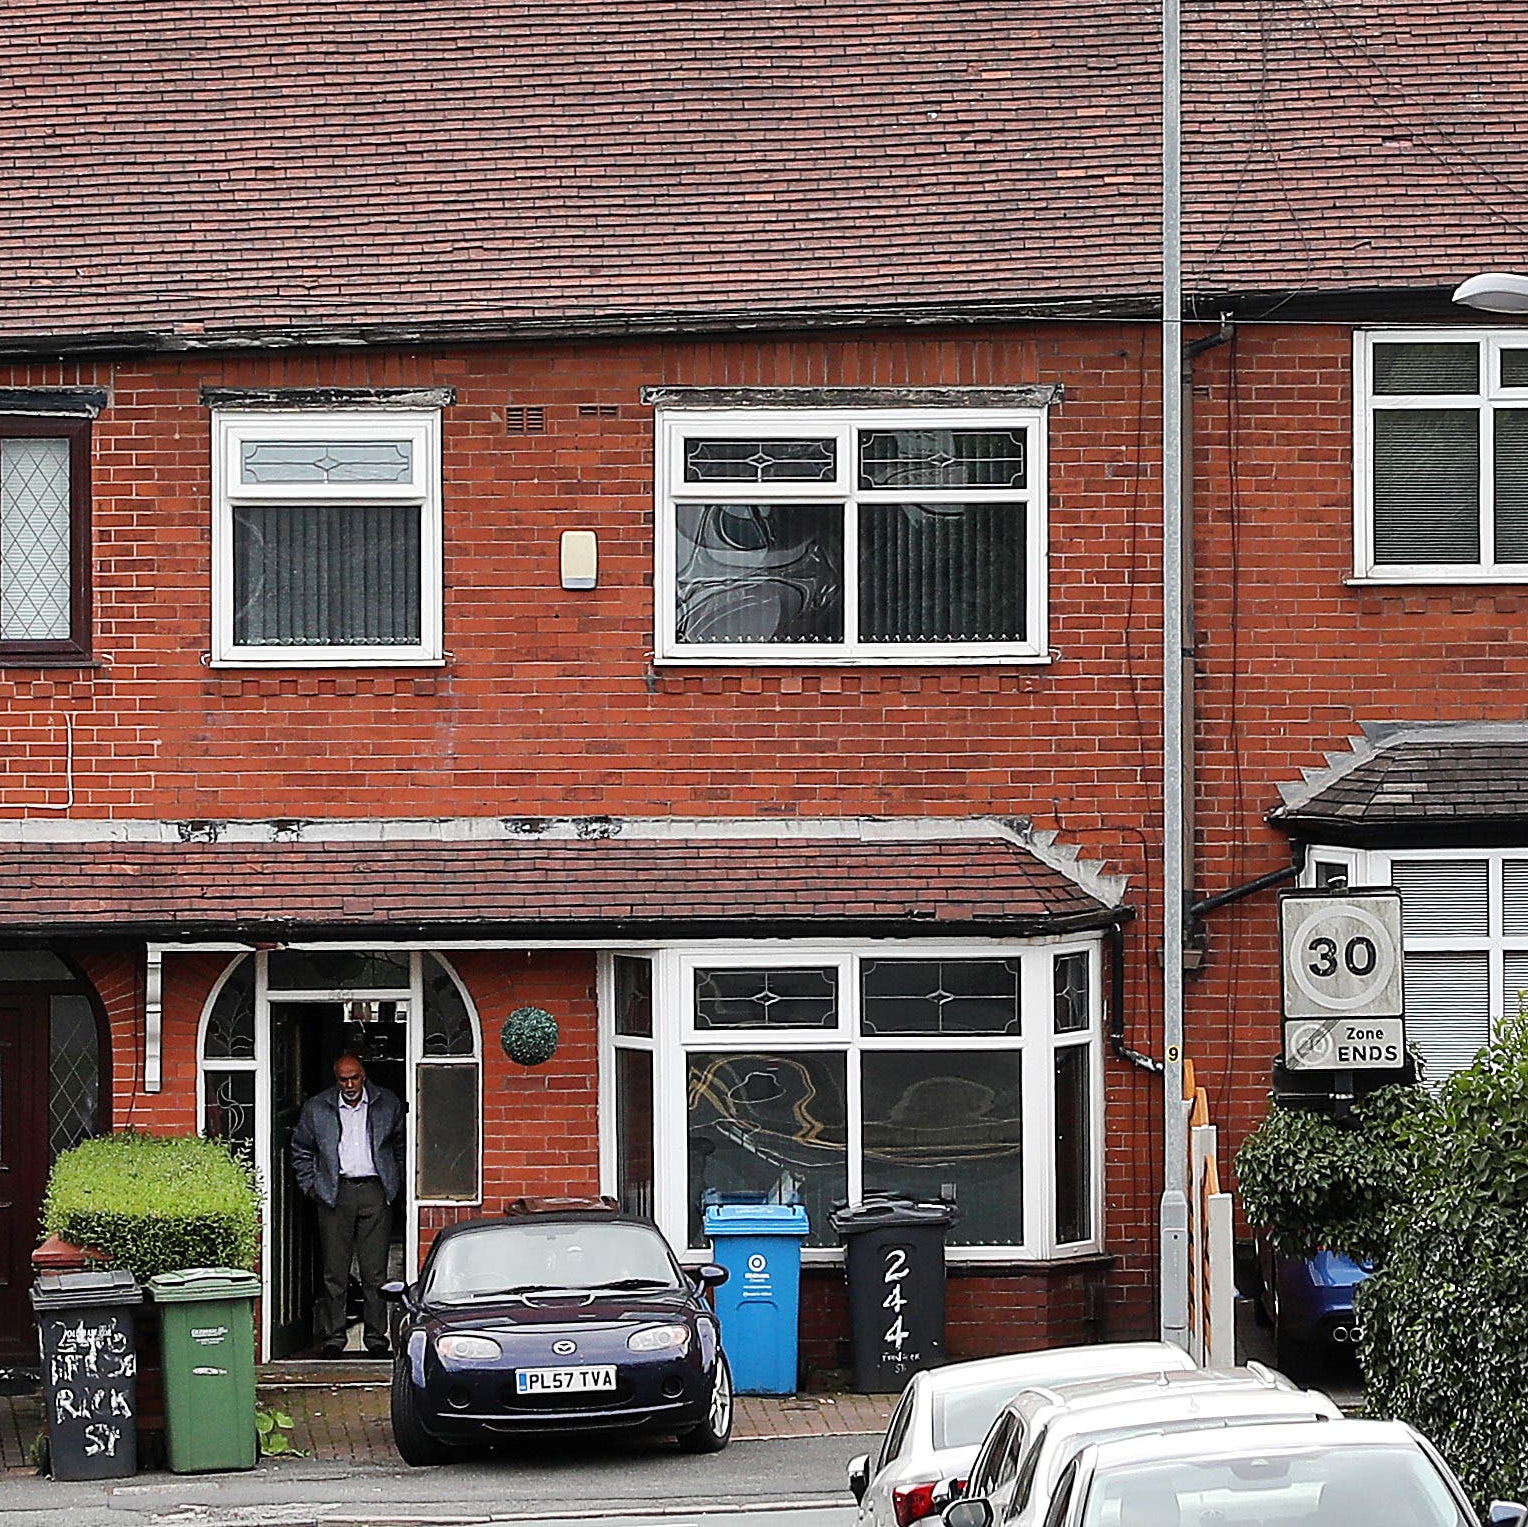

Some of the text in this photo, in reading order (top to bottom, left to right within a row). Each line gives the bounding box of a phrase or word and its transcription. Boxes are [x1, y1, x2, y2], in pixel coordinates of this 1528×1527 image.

[1308, 936, 1377, 977] 30
[1346, 1027, 1384, 1040] Zone
[1168, 1046, 1179, 1062] 9
[1338, 1046, 1398, 1062] ENDS
[529, 1370, 612, 1390] PL57 TVA
